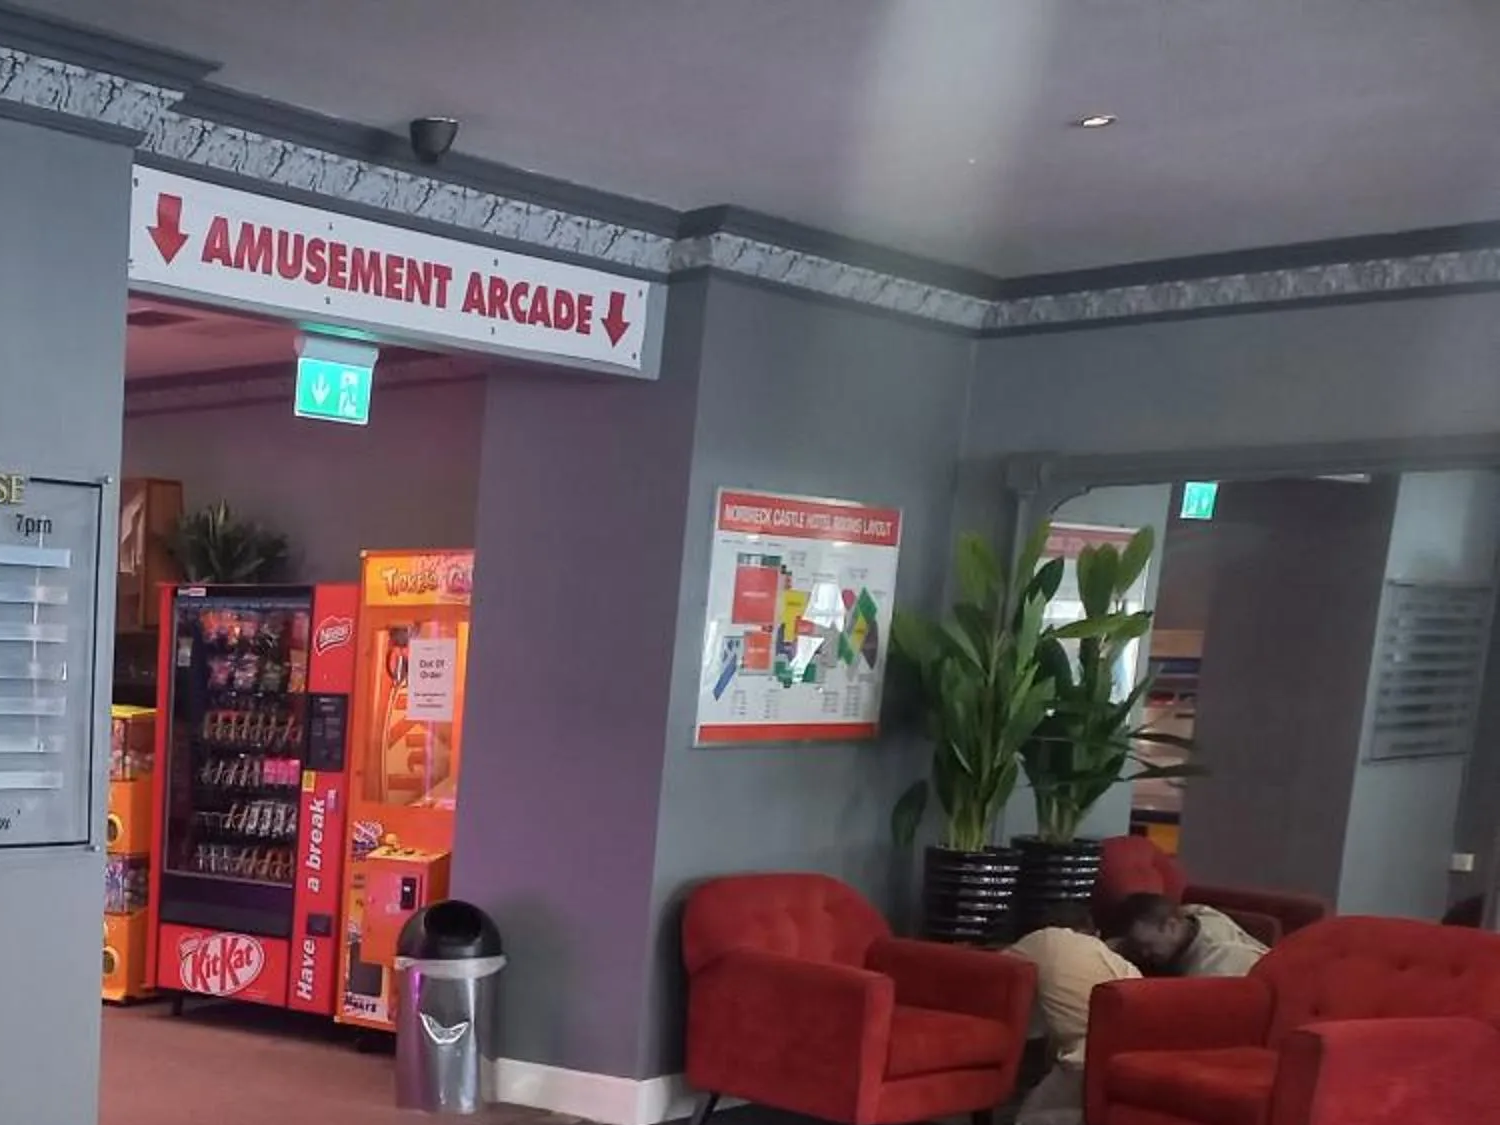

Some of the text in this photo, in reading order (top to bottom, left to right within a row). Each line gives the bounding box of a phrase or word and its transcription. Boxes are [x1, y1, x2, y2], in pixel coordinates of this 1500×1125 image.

[201, 216, 593, 334] AMUSEMENT ARCADE
[16, 514, 53, 536] 7pm
[773, 508, 804, 528] CASTLE
[297, 799, 325, 1000] Have a break
[190, 937, 254, 993] KitKat
